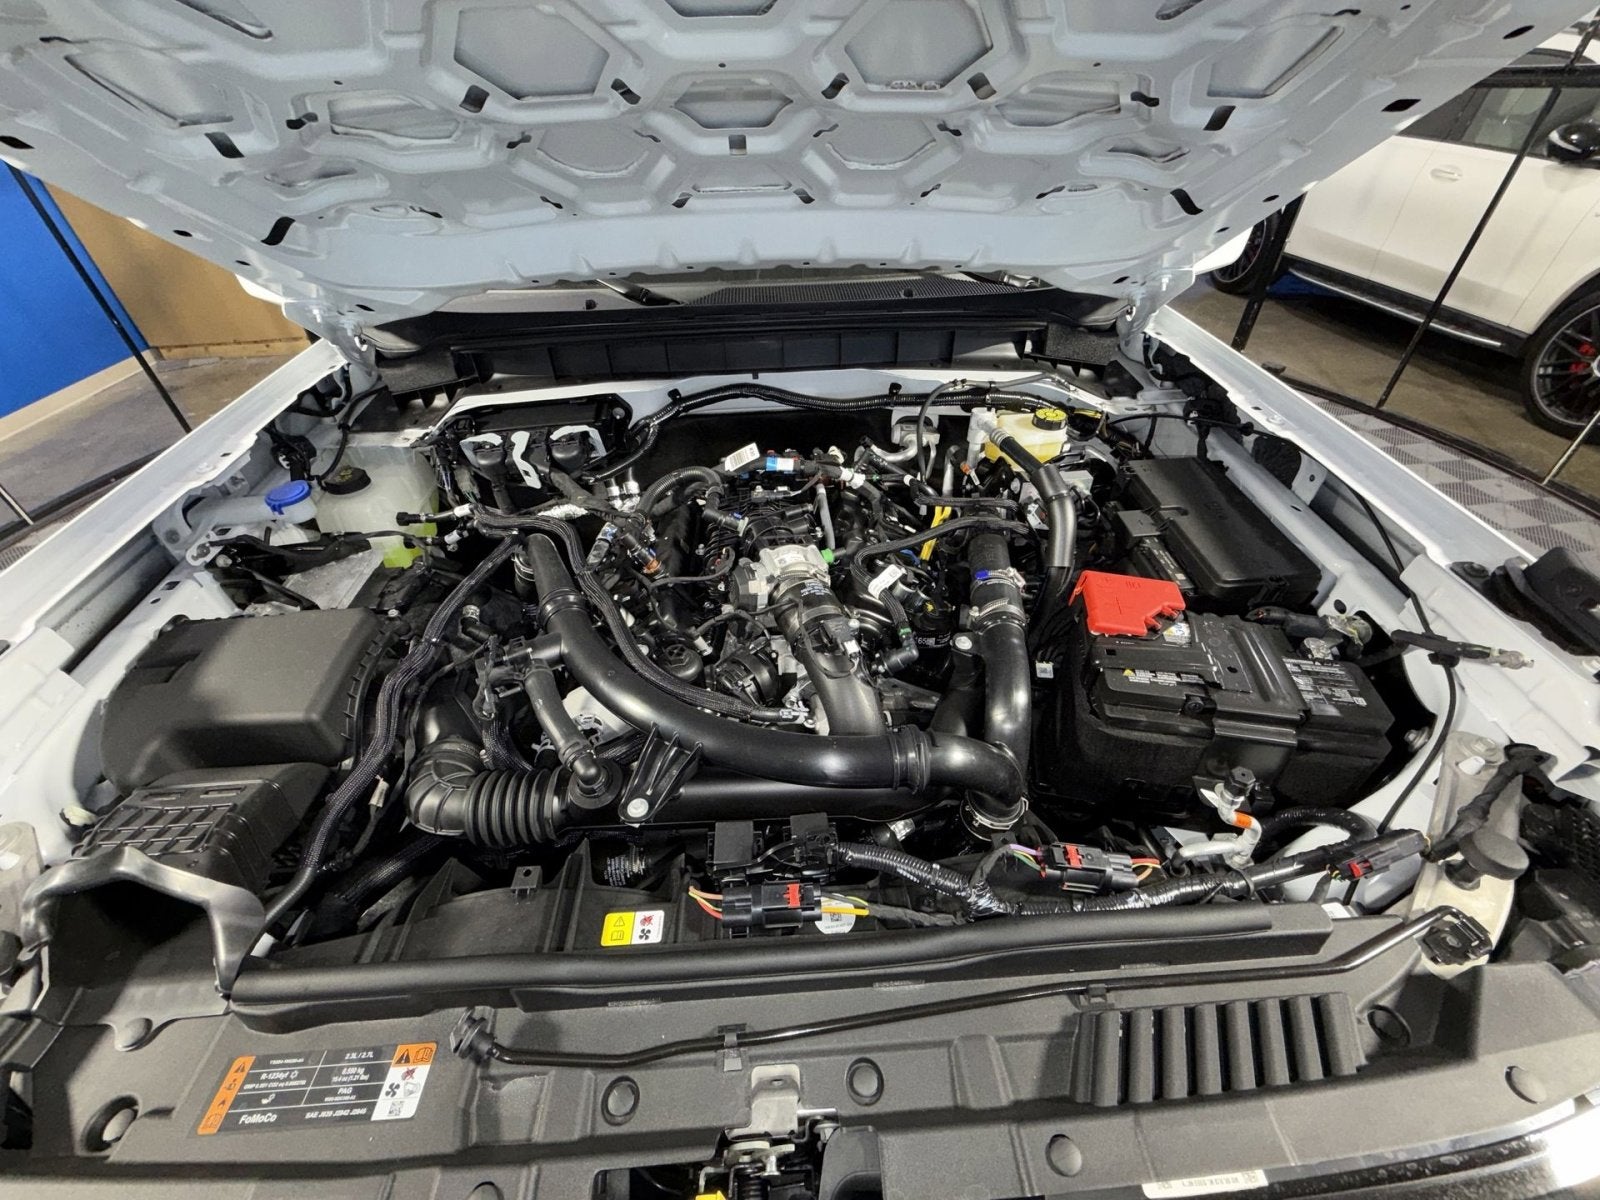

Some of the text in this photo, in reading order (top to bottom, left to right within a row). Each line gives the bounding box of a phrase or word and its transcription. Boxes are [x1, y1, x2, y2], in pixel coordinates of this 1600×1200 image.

[337, 1087, 353, 1095] PAG
[238, 1112, 278, 1125] FoMoCo
[305, 1111, 319, 1119] SAE
